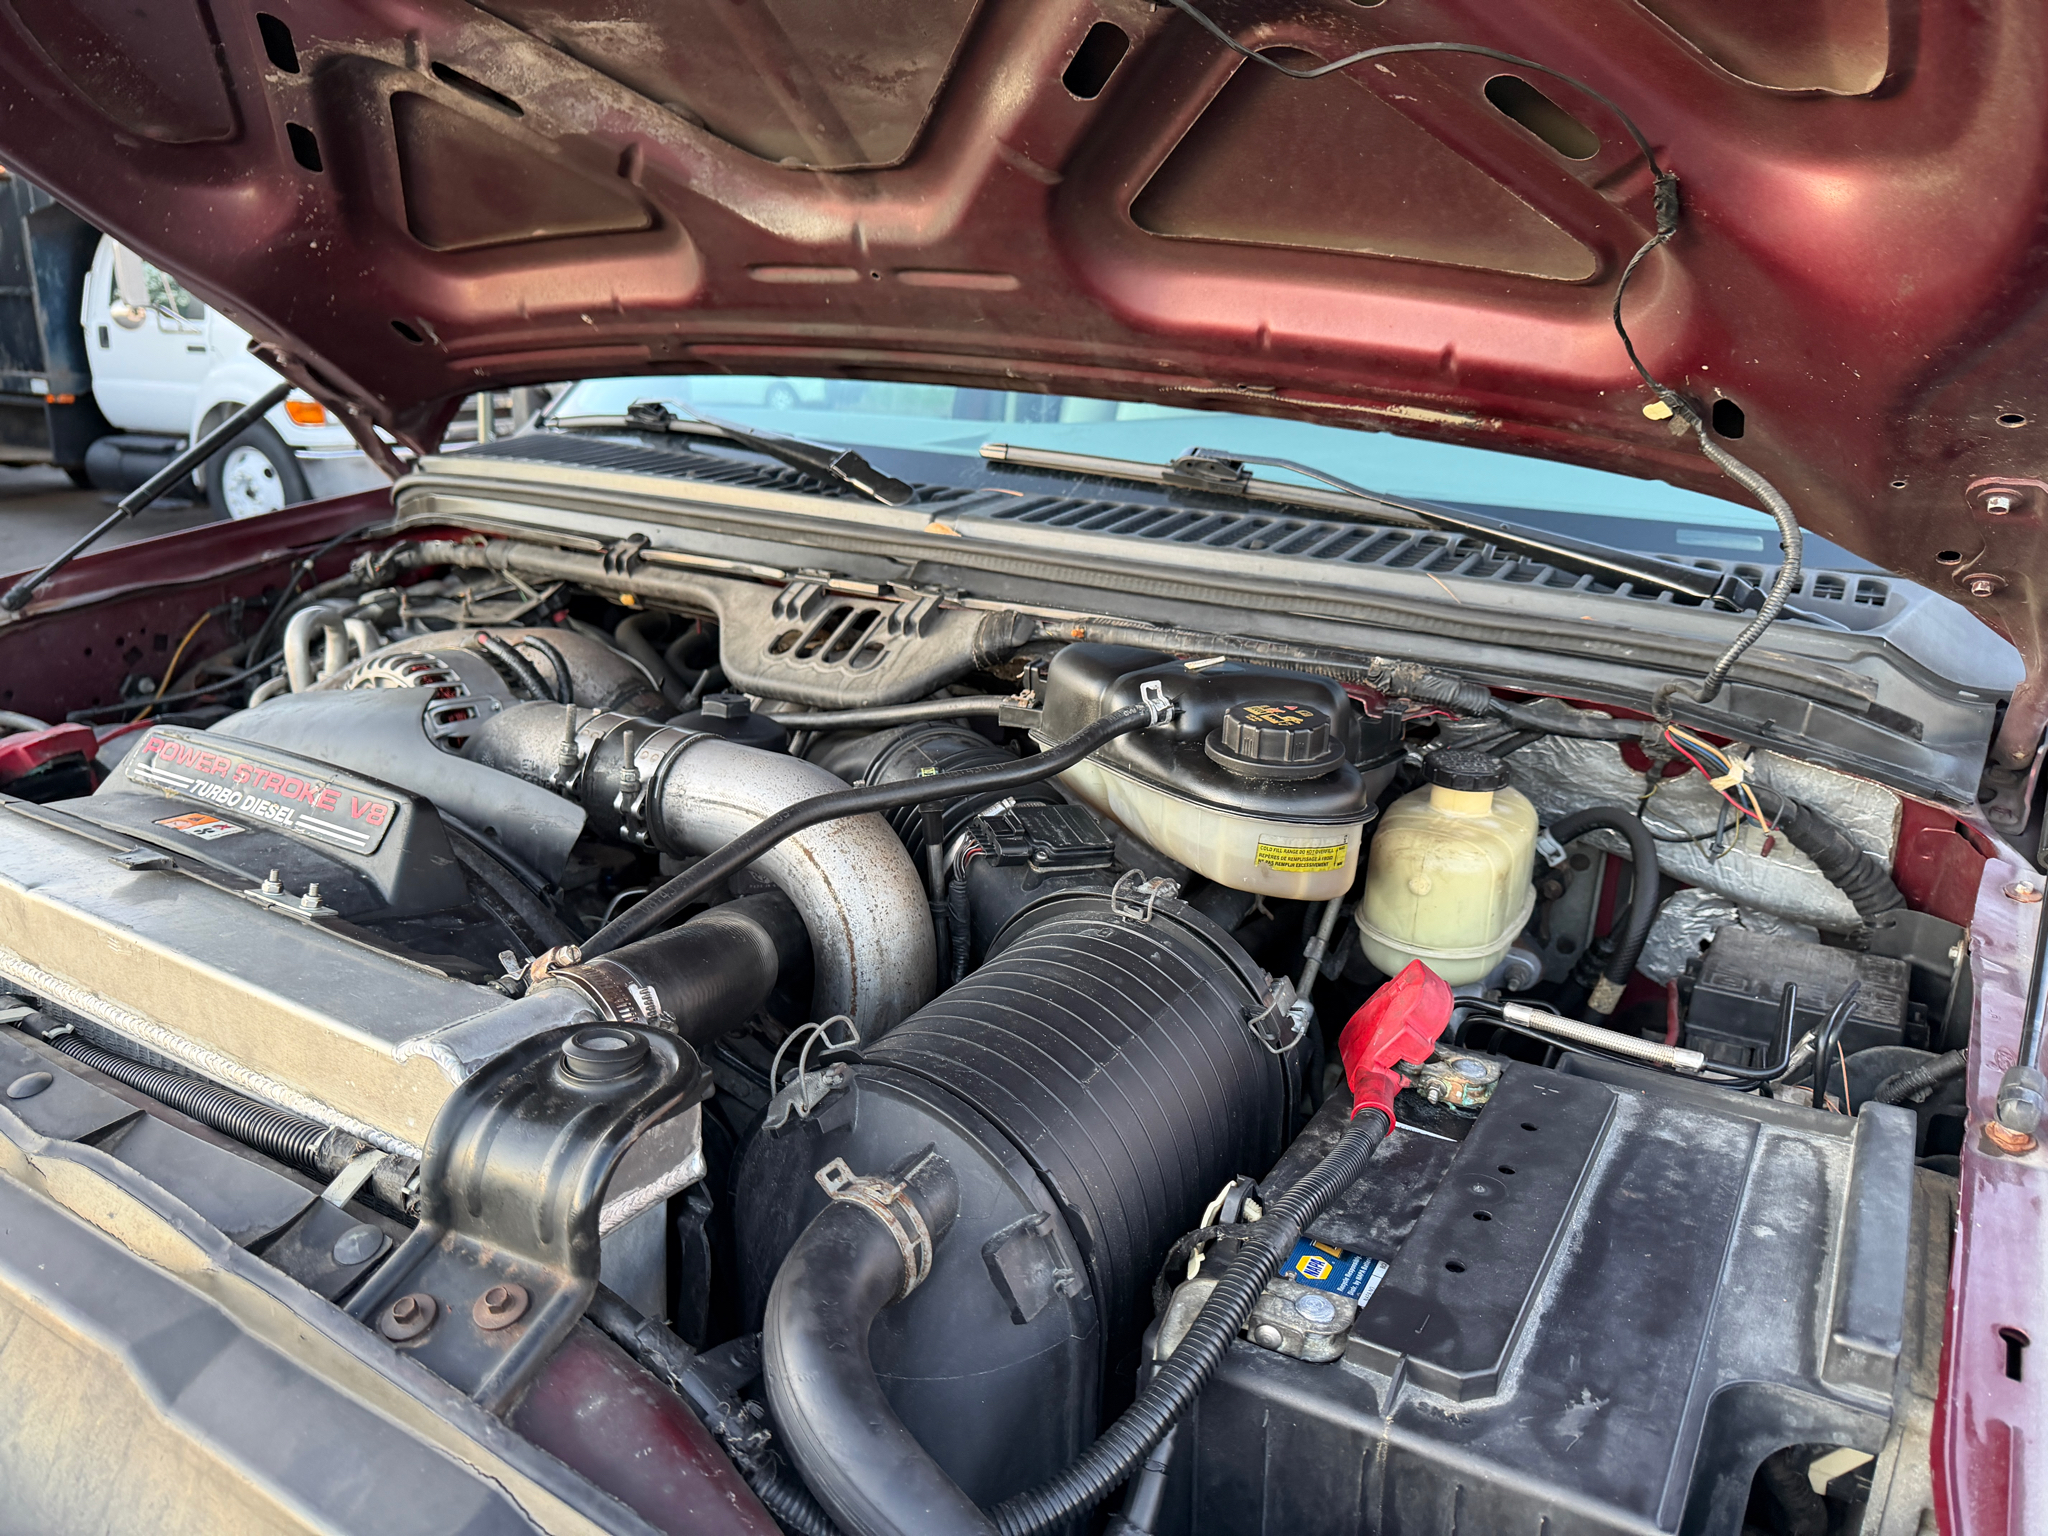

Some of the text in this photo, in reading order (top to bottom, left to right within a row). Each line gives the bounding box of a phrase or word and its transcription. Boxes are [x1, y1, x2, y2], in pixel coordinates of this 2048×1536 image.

[142, 737, 388, 826] POWER STROKE V8
[191, 780, 296, 826] TURBO DIESEL
[1303, 1258, 1326, 1278] NAPA
